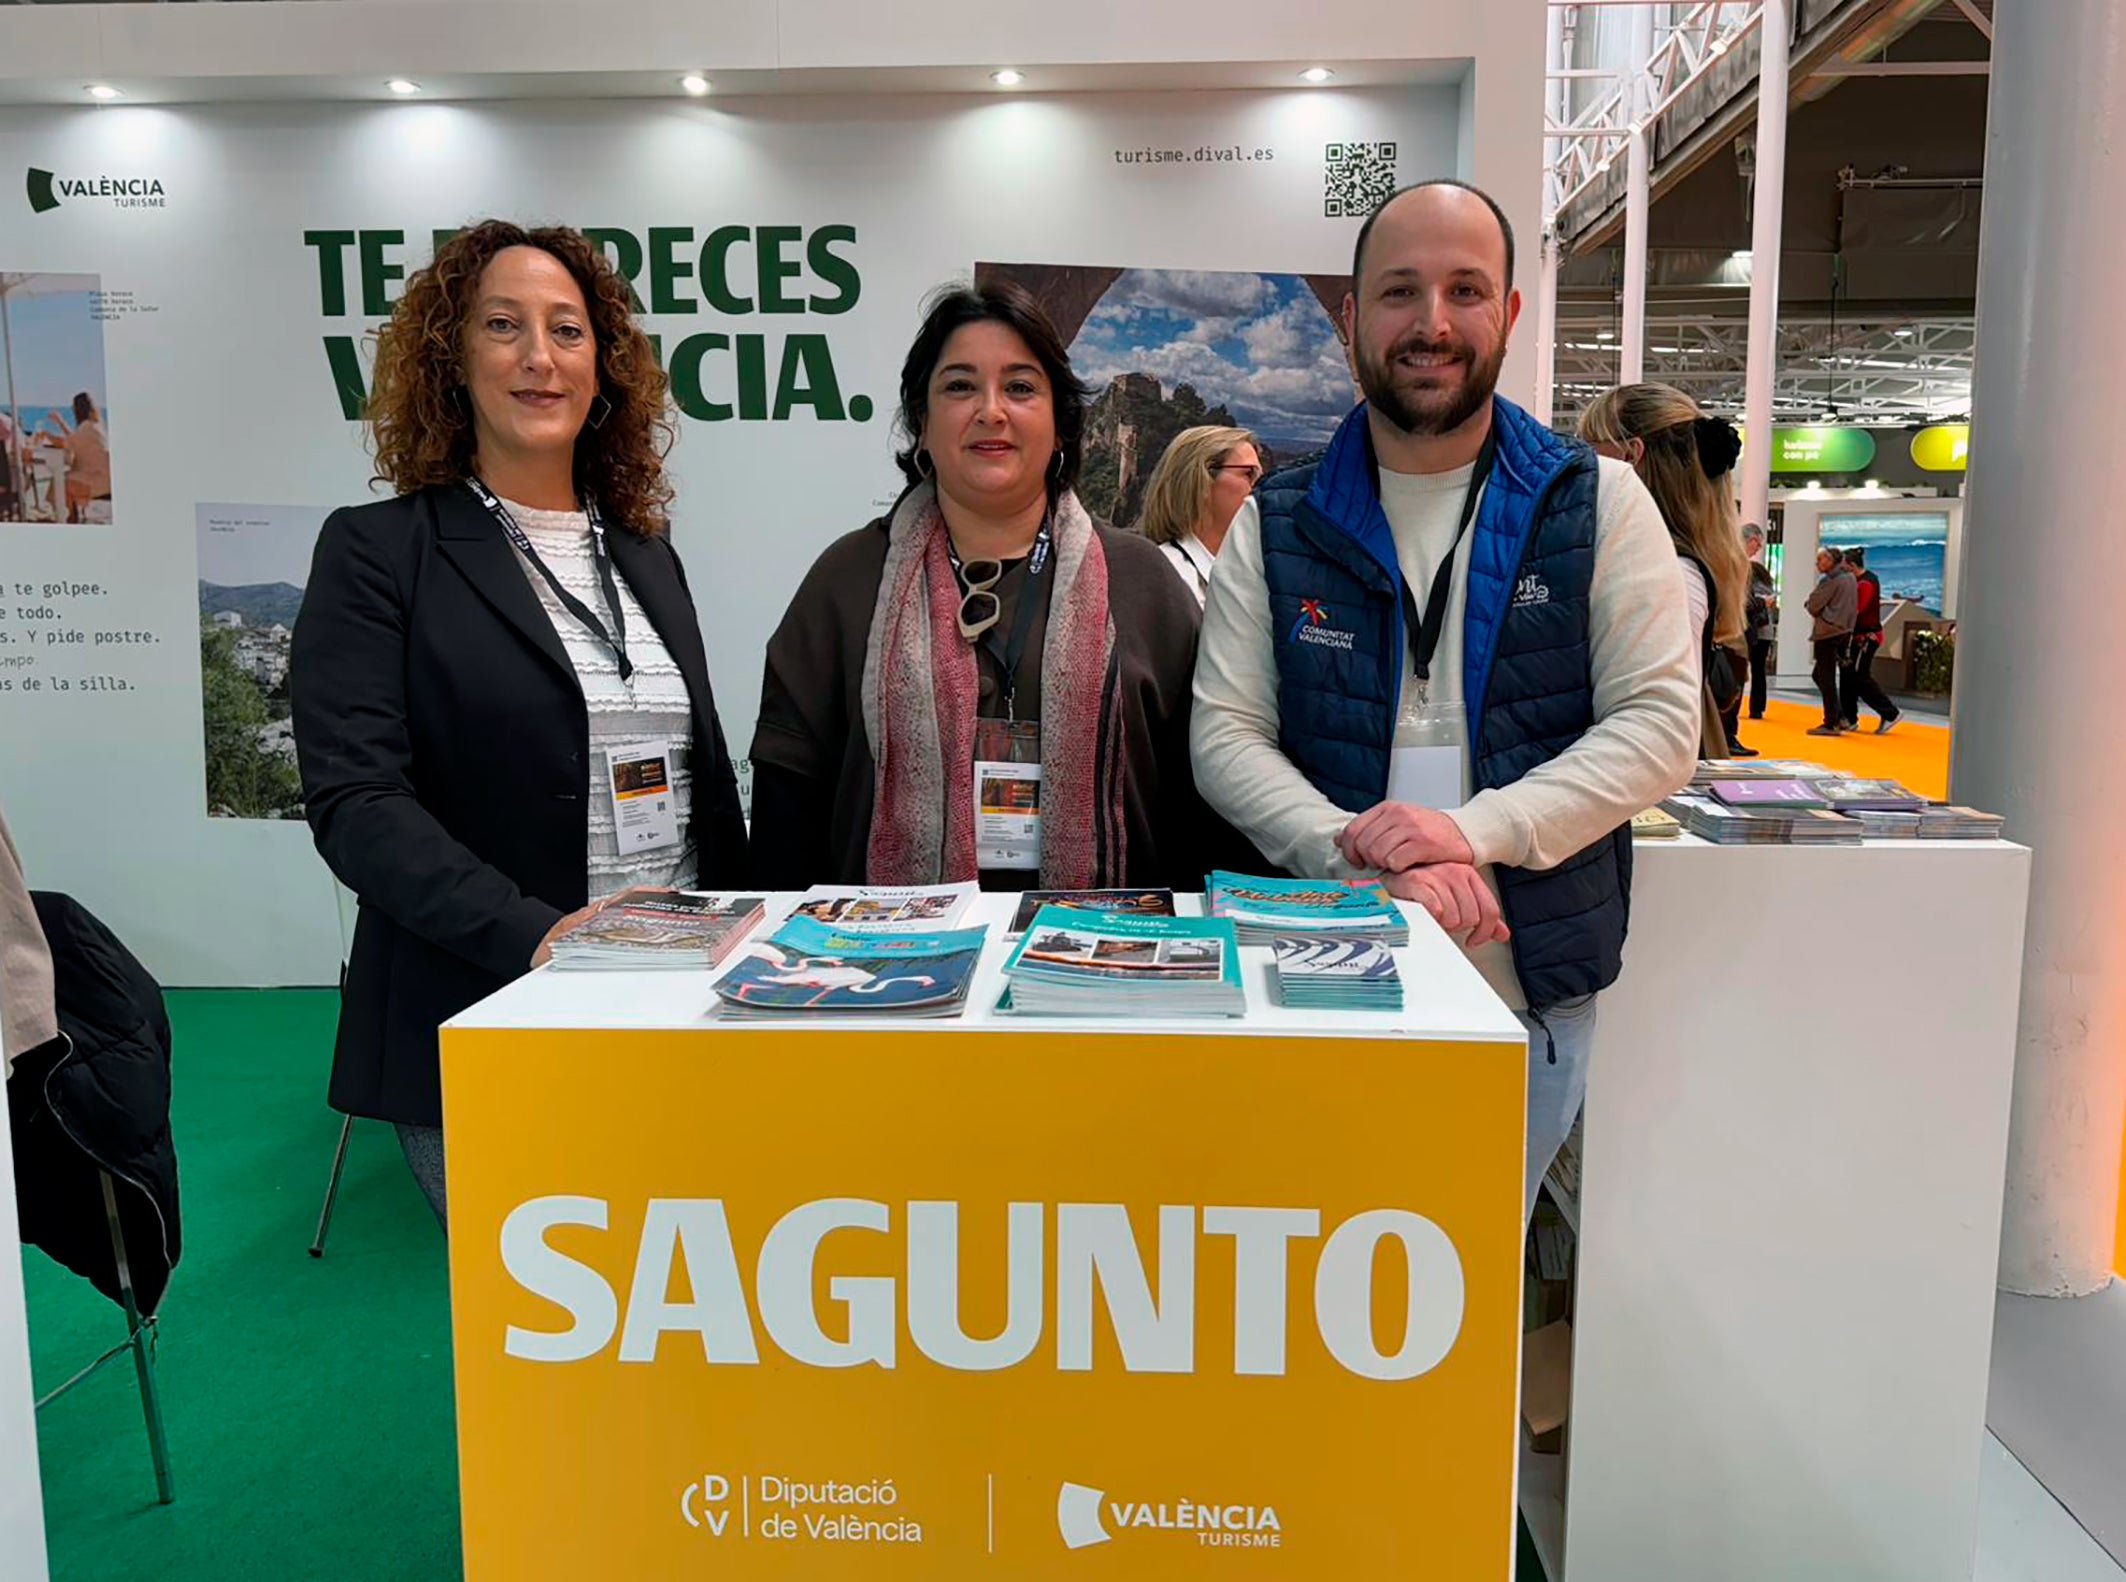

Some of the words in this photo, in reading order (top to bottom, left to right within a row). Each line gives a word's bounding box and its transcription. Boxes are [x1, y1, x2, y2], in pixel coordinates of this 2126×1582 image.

[1115, 146, 1274, 164] turisme.dival.es
[59, 175, 165, 197] VALÈNCIA
[114, 198, 166, 208] TURISME
[303, 229, 405, 317] TE
[14, 583, 33, 596] te
[42, 580, 108, 599] golpee.
[16, 605, 62, 620] todo.
[27, 629, 37, 643] Y
[46, 628, 85, 646] pide
[94, 630, 160, 646] postre.
[1298, 632, 1353, 650] VALENCIANA
[1302, 624, 1355, 641] COMUNITAT
[22, 676, 41, 691] de
[50, 676, 70, 691] la
[79, 676, 135, 691] silla.
[500, 1195, 1464, 1381] SAGUNTO
[761, 1476, 897, 1508] Diputació
[1110, 1498, 1282, 1532] VALÈNCIA
[761, 1513, 797, 1539] de
[803, 1513, 922, 1543] València
[1197, 1532, 1281, 1548] TURISME
